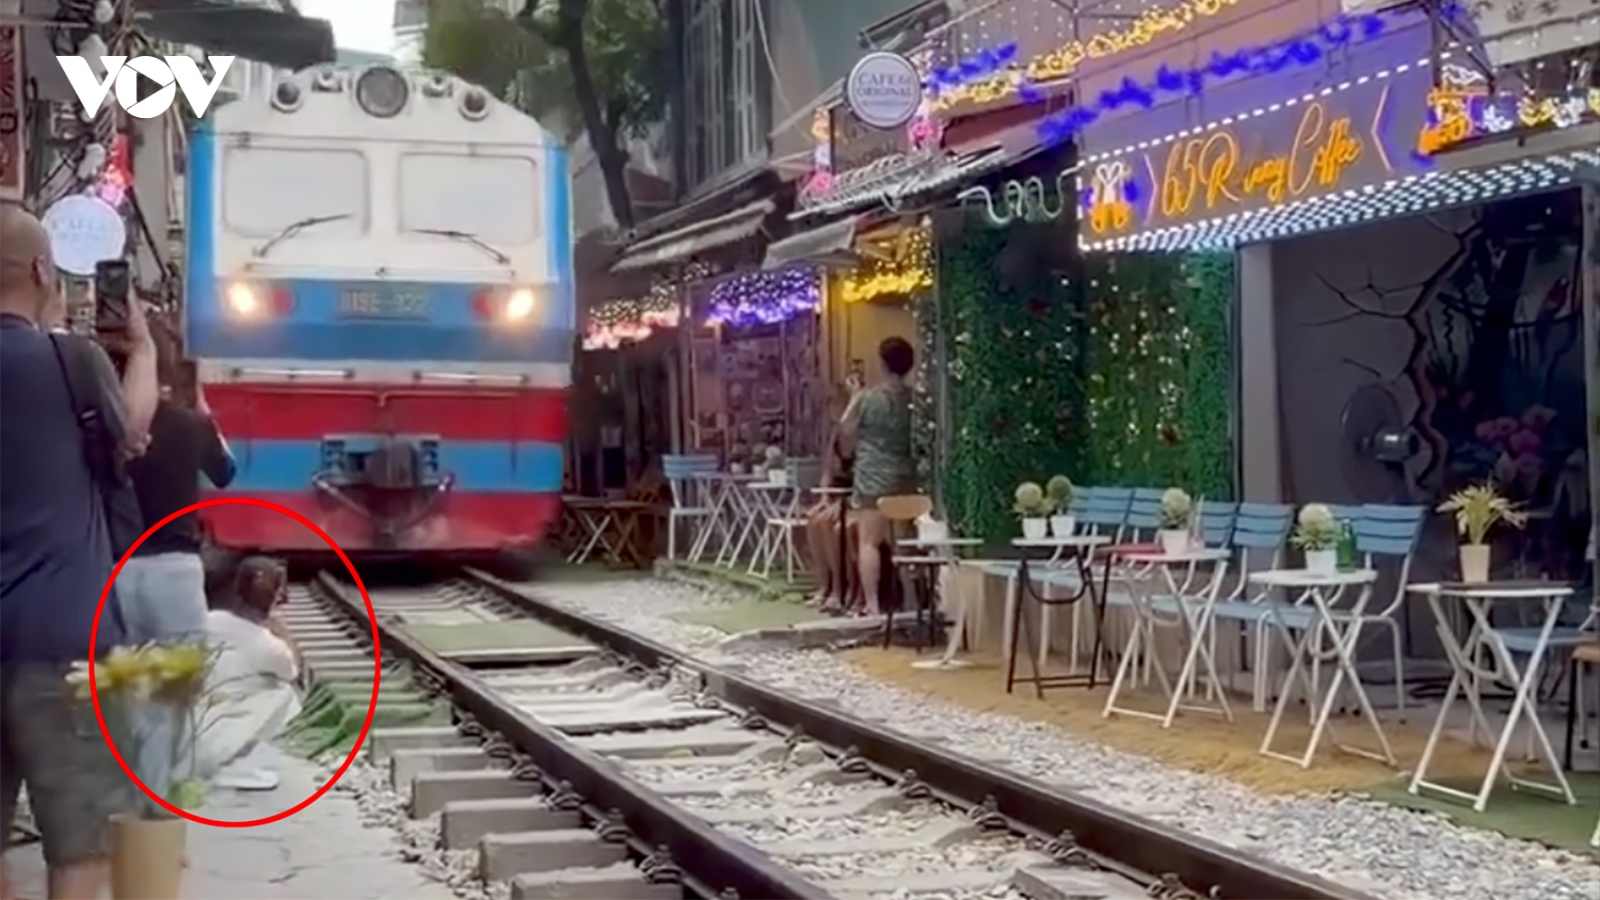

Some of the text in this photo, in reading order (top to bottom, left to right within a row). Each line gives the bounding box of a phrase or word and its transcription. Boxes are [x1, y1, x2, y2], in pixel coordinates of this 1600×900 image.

[858, 72, 897, 85] CAFE
[856, 87, 913, 98] ORIGINAL
[1288, 102, 1364, 196] Coffee
